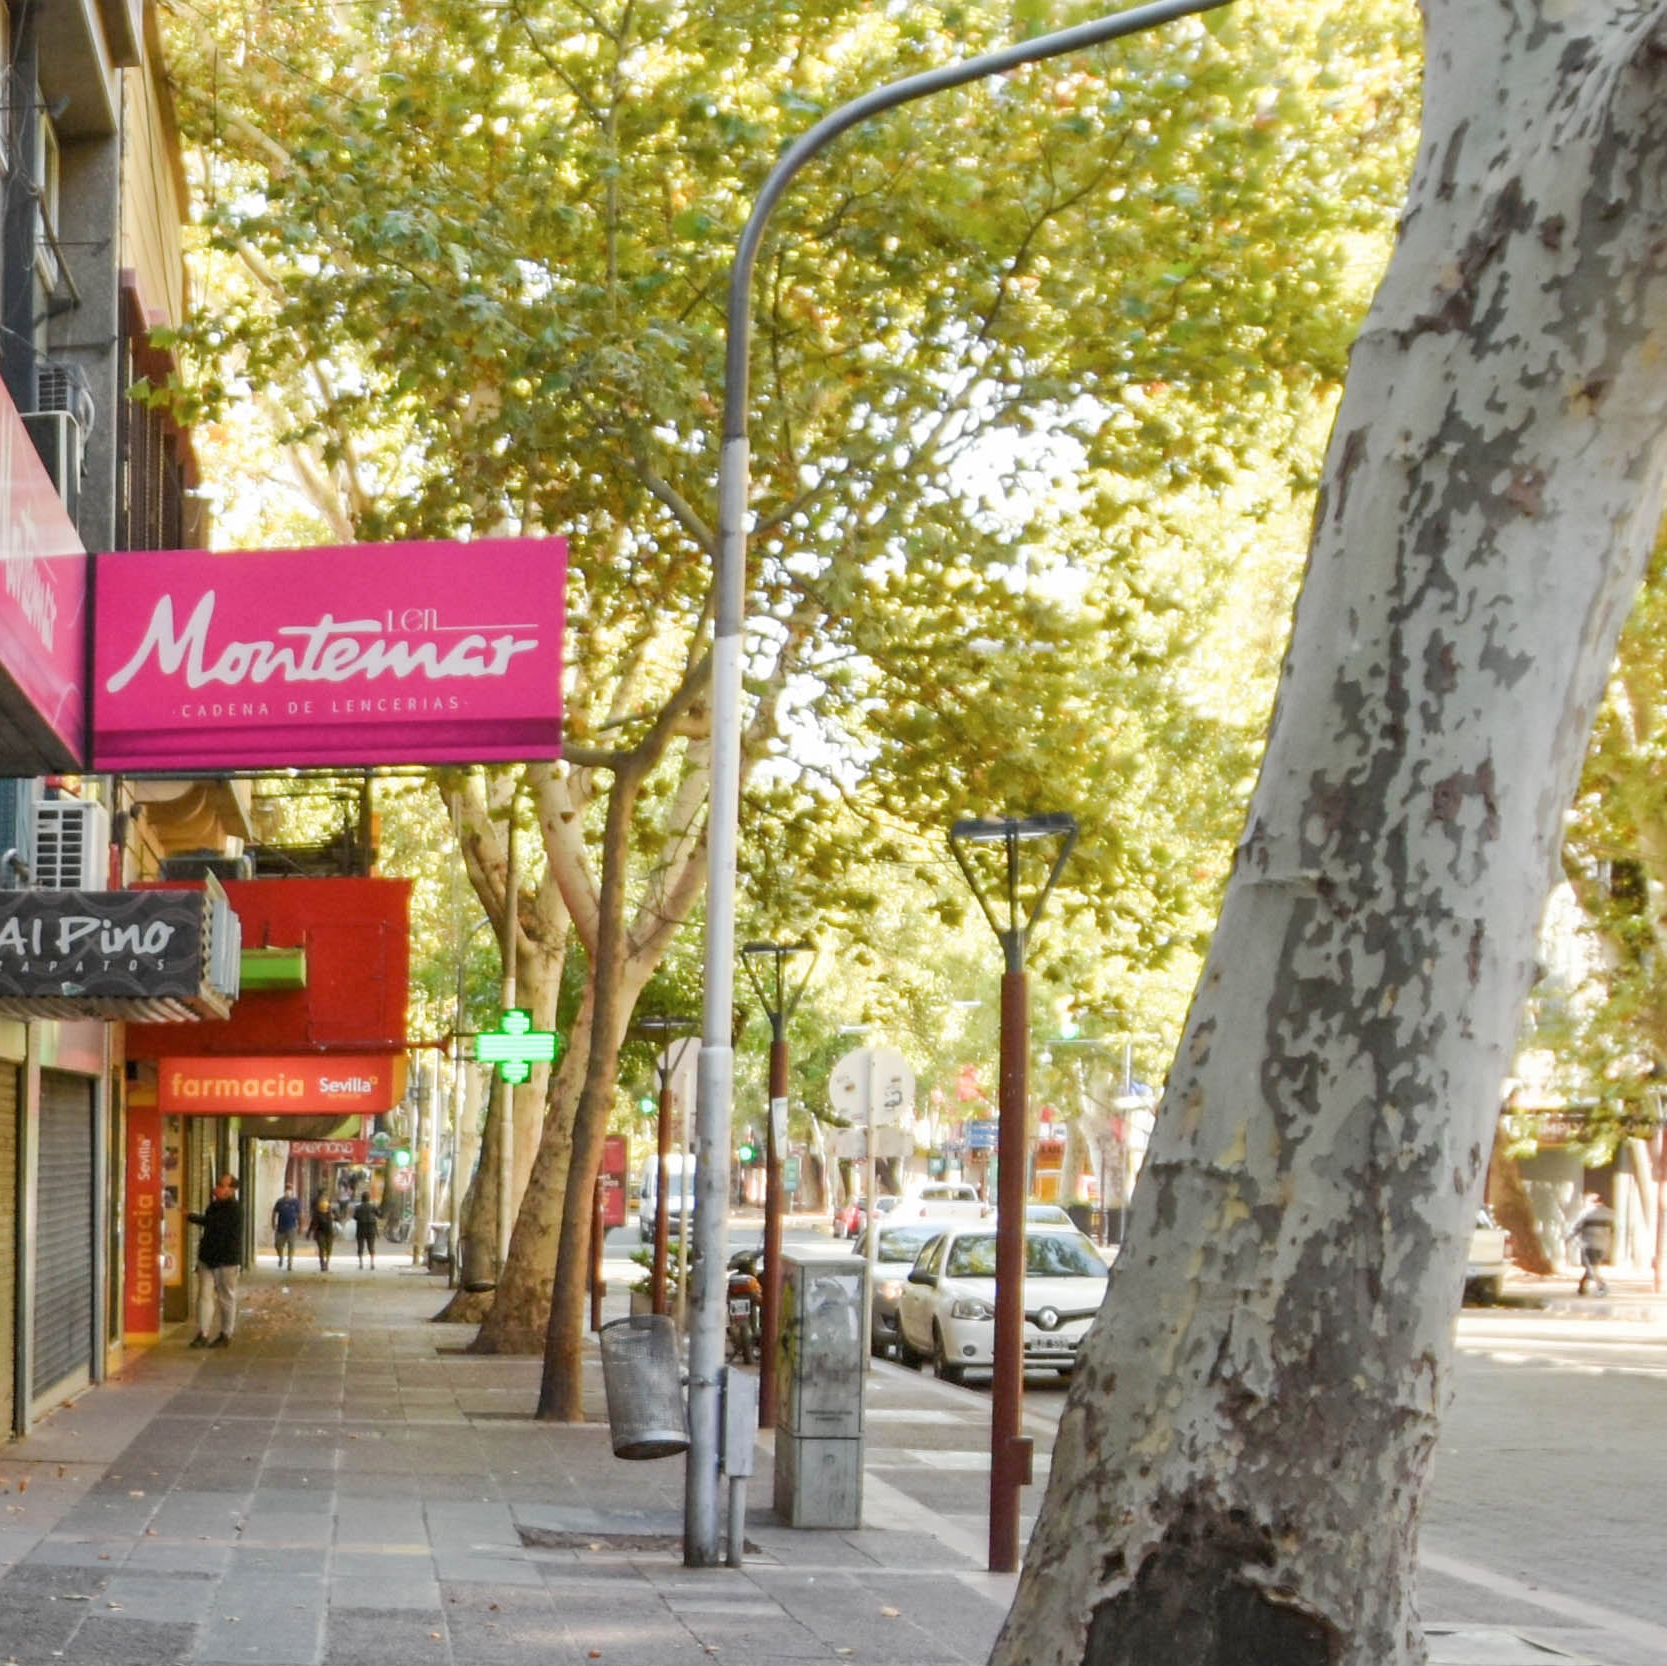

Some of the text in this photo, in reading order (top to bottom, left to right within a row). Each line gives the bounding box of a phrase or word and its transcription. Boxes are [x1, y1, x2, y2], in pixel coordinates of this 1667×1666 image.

[105, 589, 539, 693] Montemar
[181, 695, 461, 719] CADENA DE LENCERIAS
[54, 916, 176, 955] Pino
[170, 1072, 372, 1097] farmacia Sevilla
[131, 1138, 155, 1308] farmacia Sevilla
